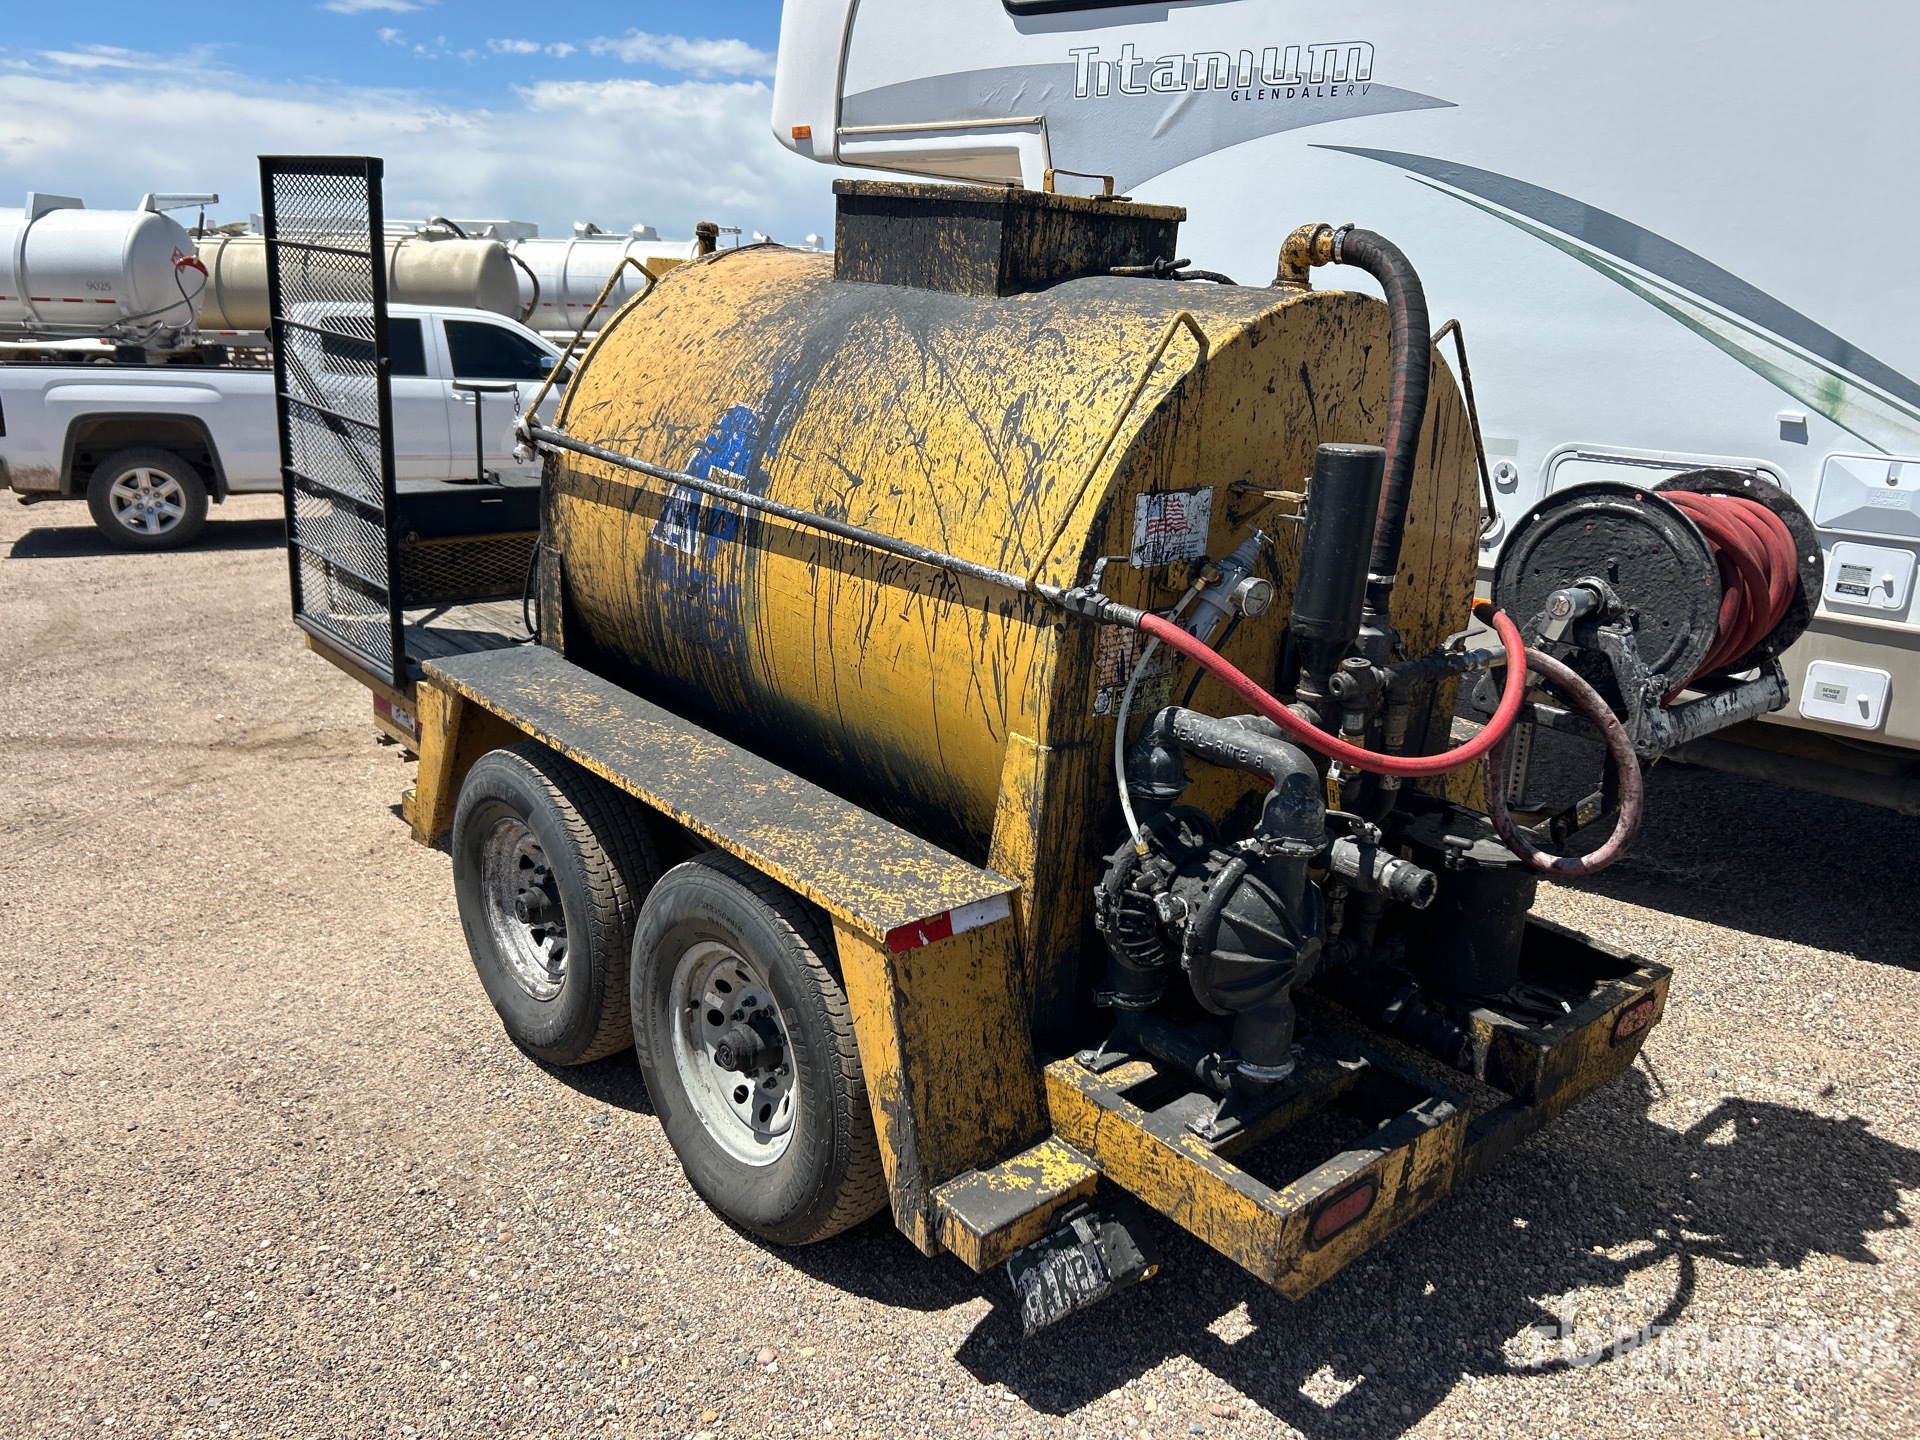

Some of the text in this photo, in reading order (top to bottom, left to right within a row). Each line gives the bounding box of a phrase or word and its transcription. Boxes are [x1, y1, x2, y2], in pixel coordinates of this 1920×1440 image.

[1068, 41, 1375, 99] Titanium
[1873, 489, 1906, 499] UTILITY
[1870, 497, 1907, 508] SHOWER
